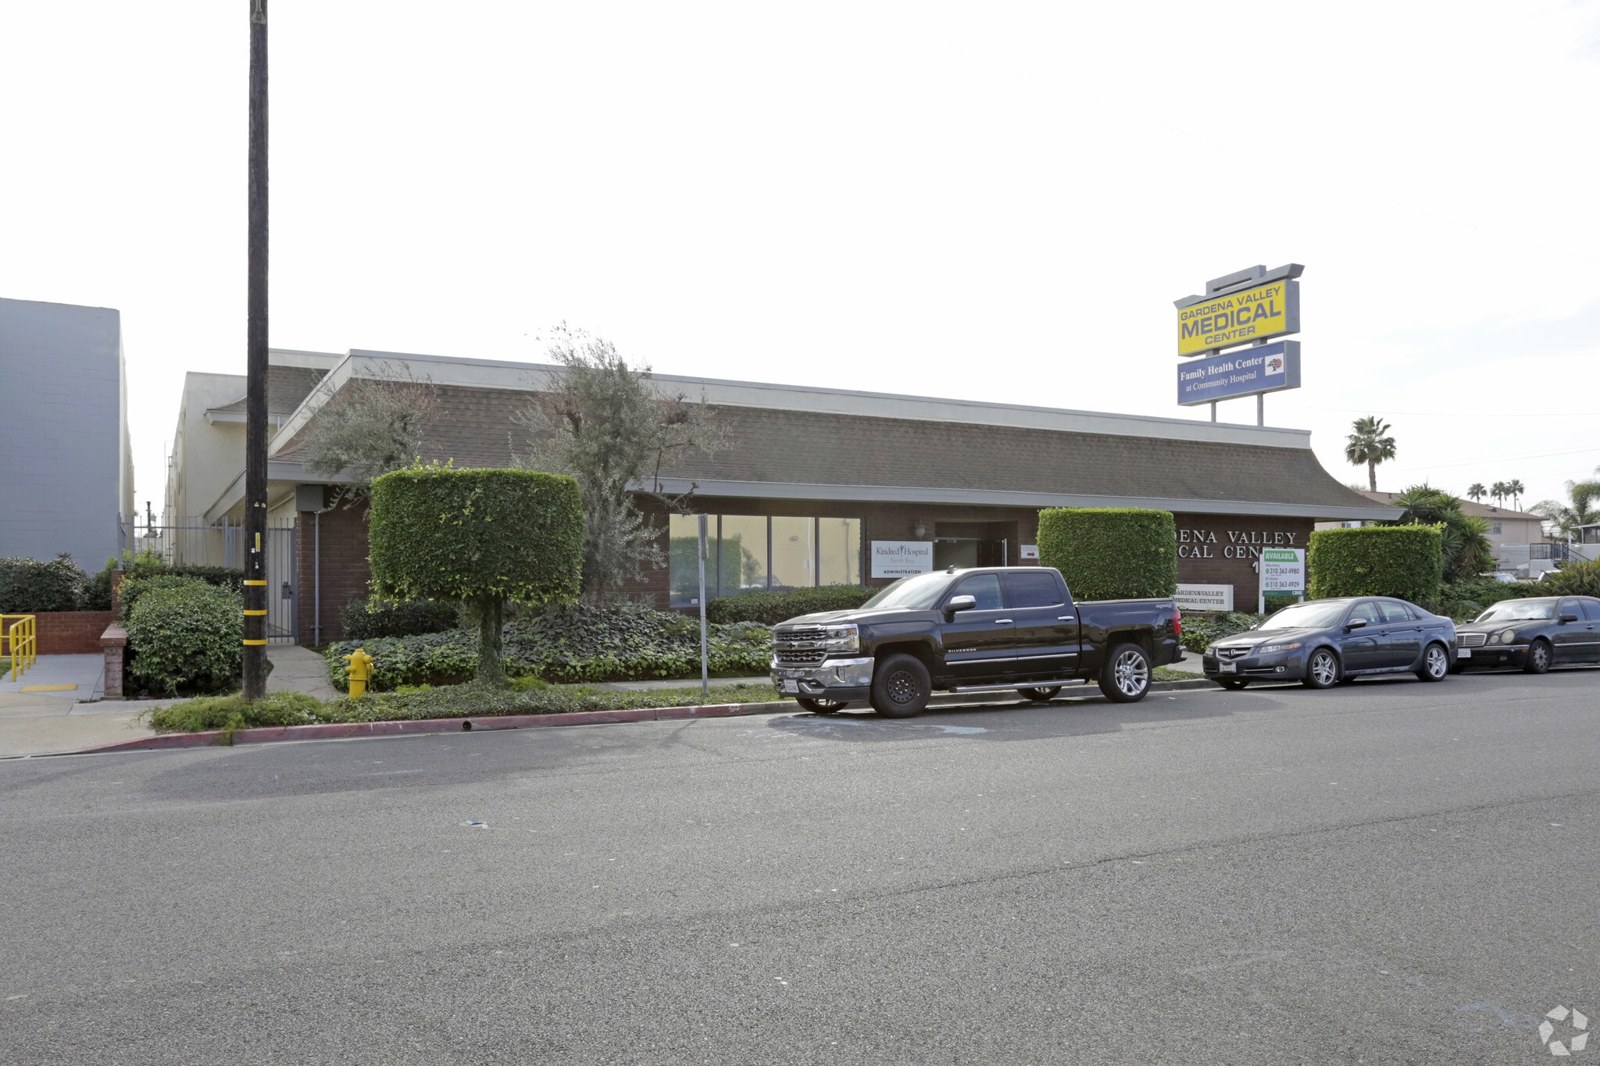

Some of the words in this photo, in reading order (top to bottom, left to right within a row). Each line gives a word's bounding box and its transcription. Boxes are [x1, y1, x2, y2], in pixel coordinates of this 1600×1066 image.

[1180, 300, 1234, 321] GARDENA
[1236, 286, 1281, 305] VALLEY
[1181, 299, 1282, 340] MEDICAL
[1204, 325, 1256, 345] CENTER
[1180, 367, 1206, 381] Family
[1208, 361, 1234, 375] Health
[1235, 356, 1264, 368] Center
[1185, 384, 1192, 392] at
[1192, 376, 1228, 391] Community
[1230, 371, 1257, 384] Hospital
[1174, 529, 1218, 543] ENA
[1227, 531, 1297, 545] VALLEY
[876, 546, 900, 555] Kindred
[904, 547, 929, 557] Hospital
[1178, 545, 1214, 558] CAL
[1224, 546, 1261, 559] CEN
[1265, 552, 1295, 560] AVAILABLE
